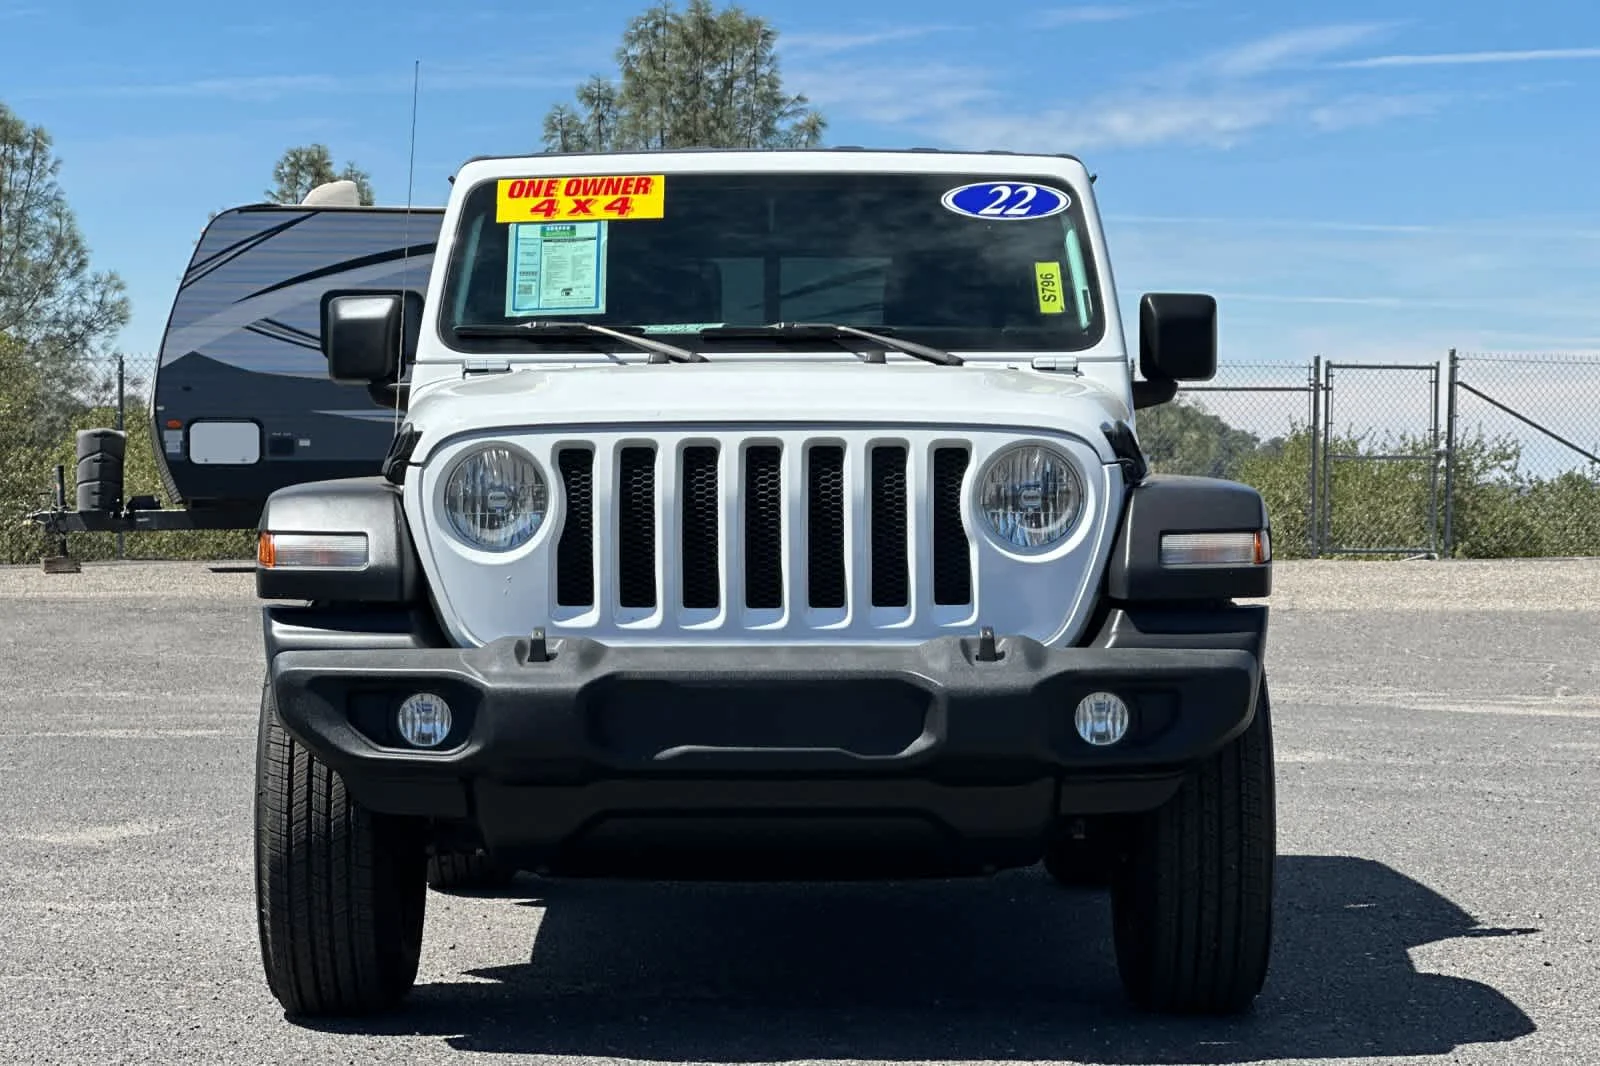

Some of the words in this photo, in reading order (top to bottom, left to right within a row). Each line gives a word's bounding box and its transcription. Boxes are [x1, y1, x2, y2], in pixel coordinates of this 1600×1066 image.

[508, 180, 559, 198] ONE
[564, 177, 653, 196] OWNER
[978, 185, 1037, 215] 22
[530, 199, 559, 218] 4
[604, 197, 633, 215] 4
[1040, 273, 1057, 302] S796
